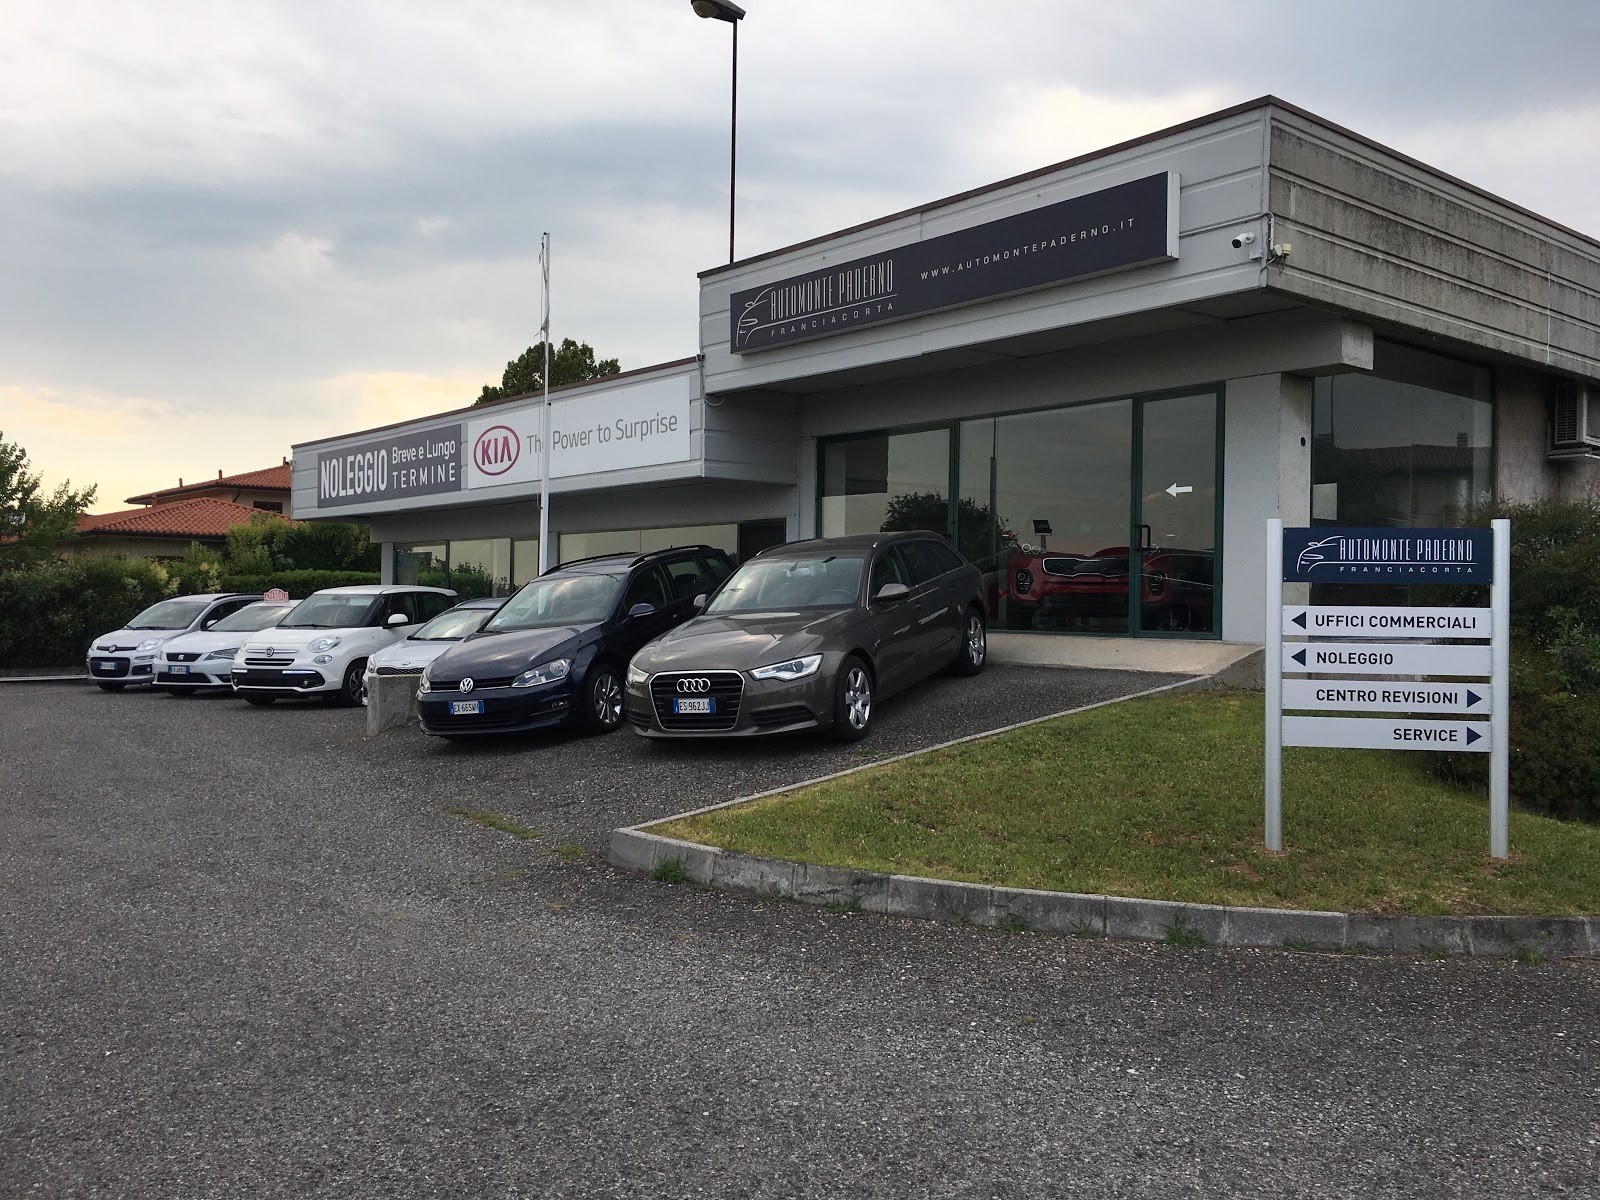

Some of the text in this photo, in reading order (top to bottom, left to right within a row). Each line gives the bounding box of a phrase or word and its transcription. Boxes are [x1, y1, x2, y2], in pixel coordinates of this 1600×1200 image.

[920, 217, 1136, 279] WWW.AUTOMONTEPADERNO.IT
[770, 259, 893, 320] AUTOMONTE PADERNO
[771, 303, 894, 337] FRANCIACORTA
[527, 412, 678, 455] Th Power to Surprise
[392, 440, 456, 464] Breve e Lungo
[481, 435, 513, 466] KIA
[320, 448, 388, 500] NOLEGGIO
[392, 462, 456, 489] TERMINE
[1340, 539, 1473, 562] AUTOMONTE PADERNO
[1315, 614, 1476, 629] UFFICI COMMERCIALI
[1316, 652, 1394, 665] NOLEGGIO
[1316, 689, 1458, 704] CENTRO REVISIONI
[1393, 728, 1458, 742] SERVICE
